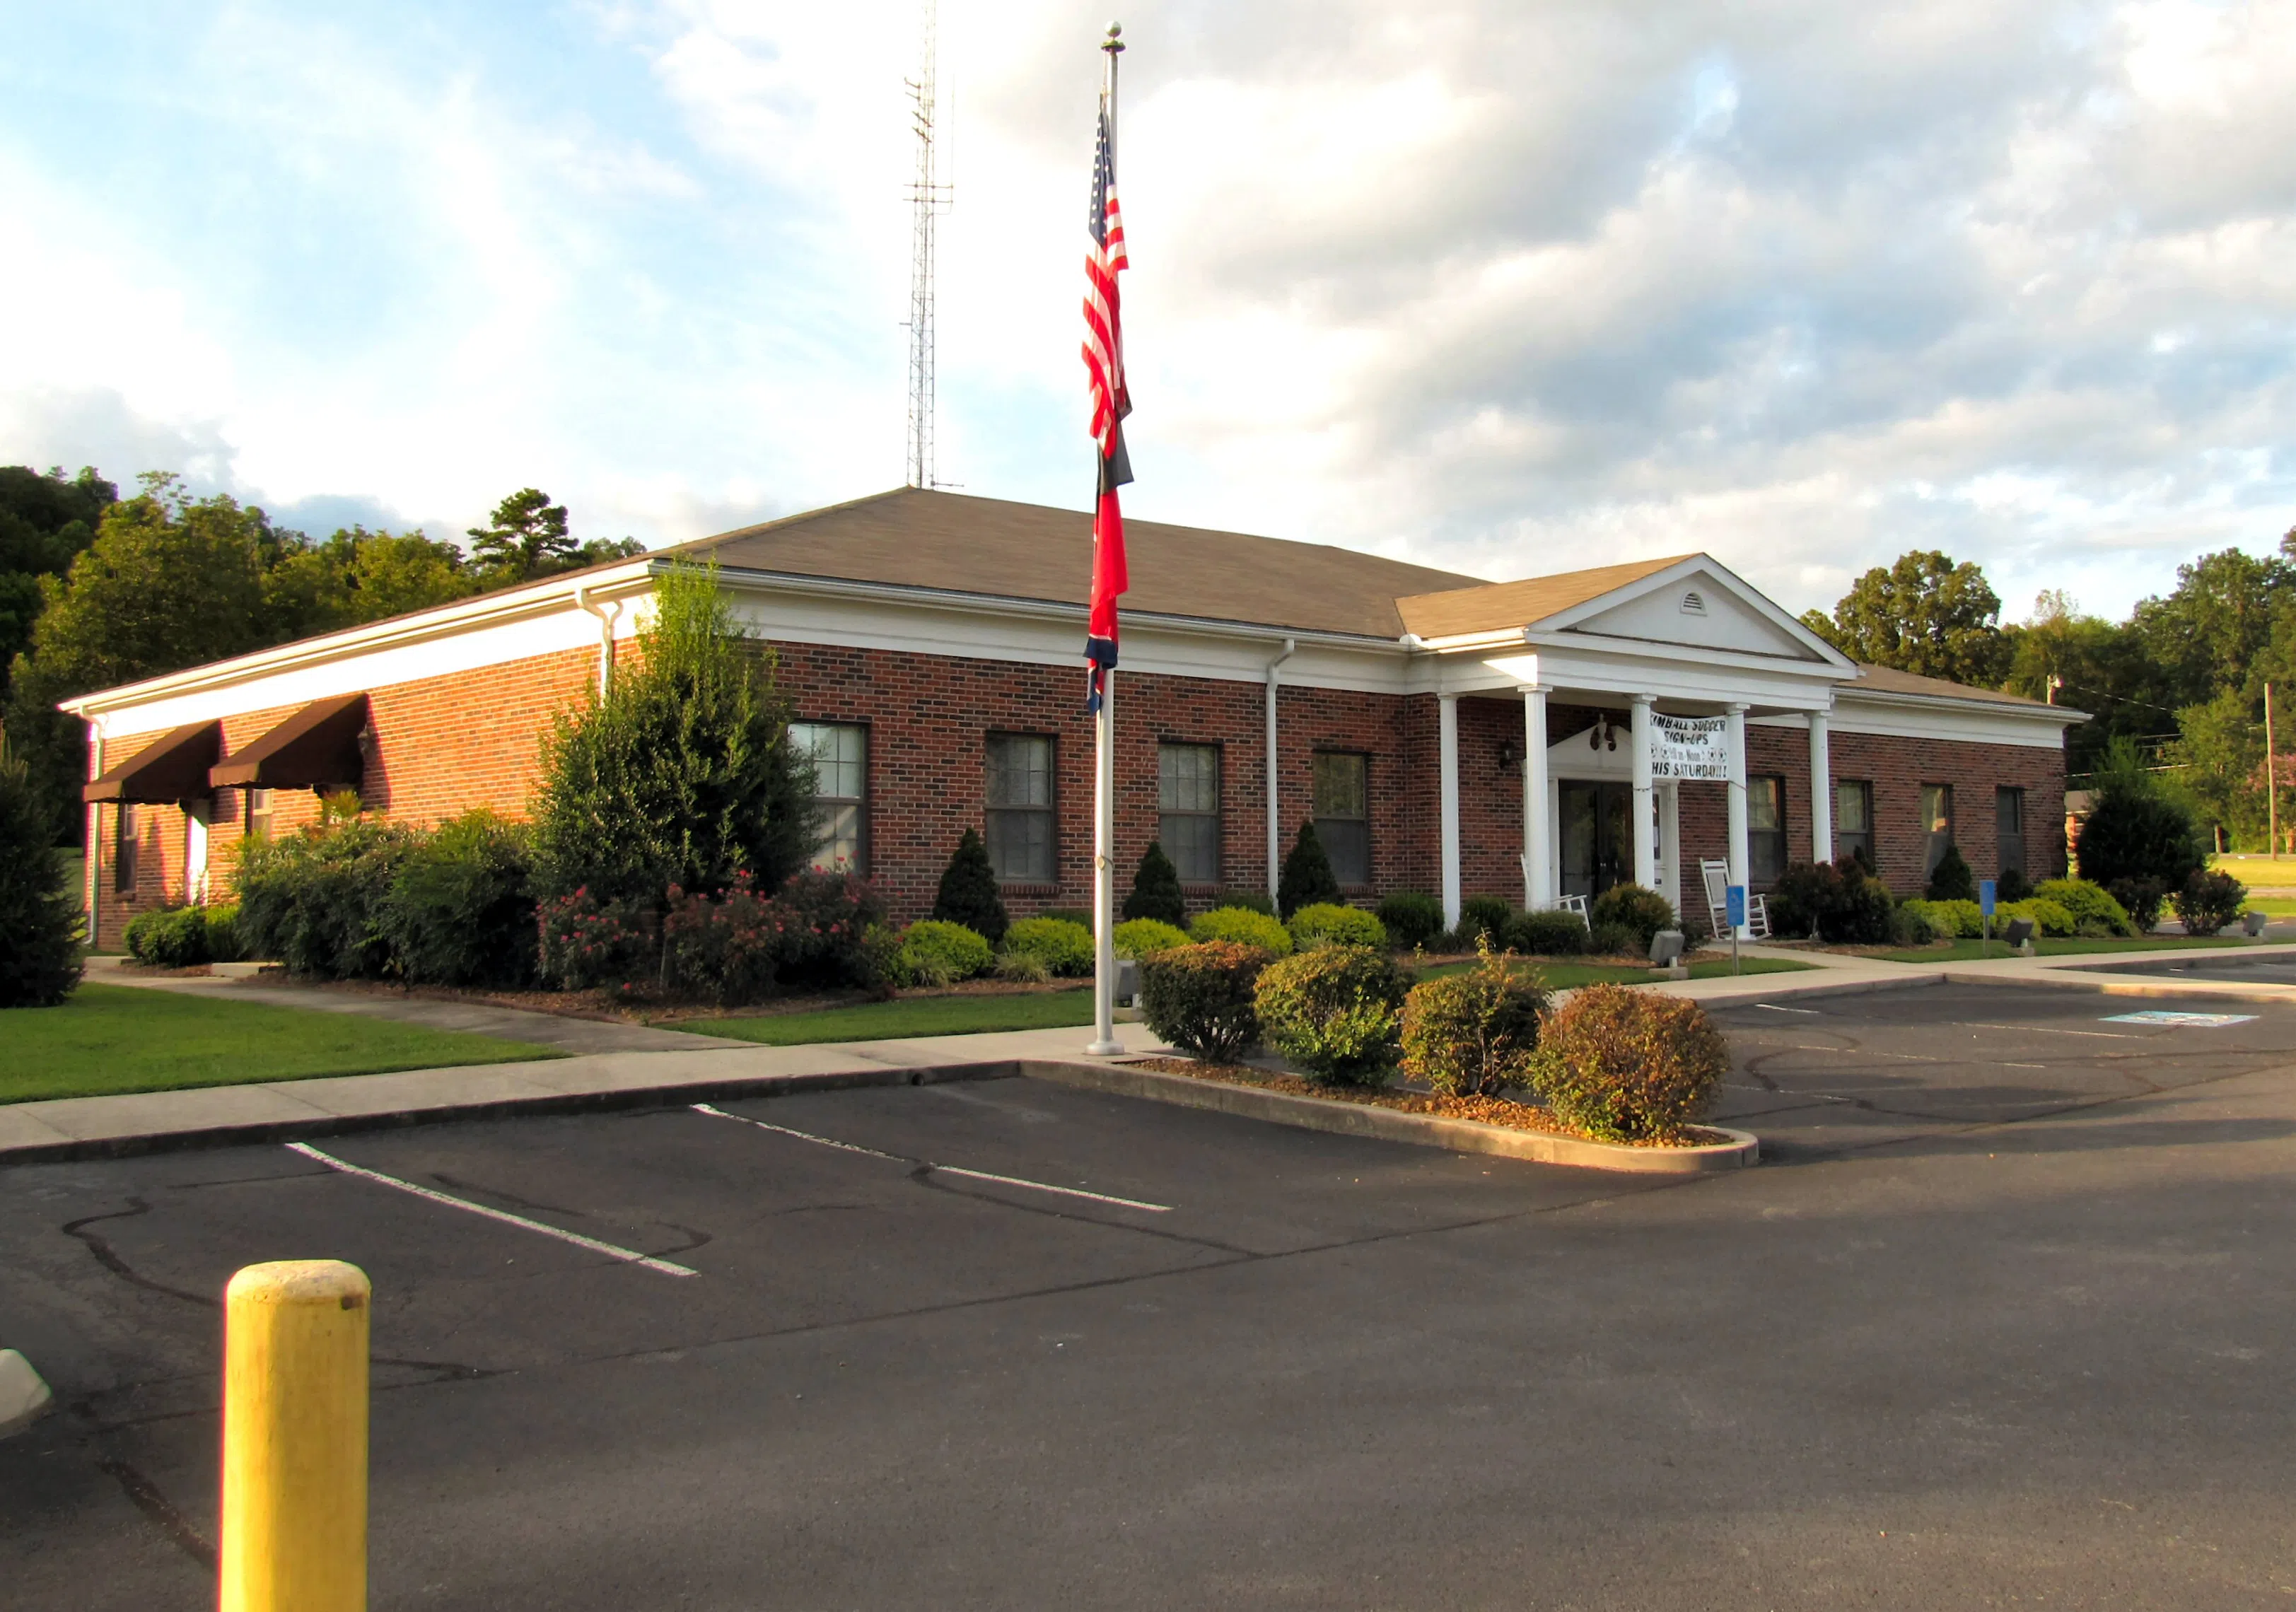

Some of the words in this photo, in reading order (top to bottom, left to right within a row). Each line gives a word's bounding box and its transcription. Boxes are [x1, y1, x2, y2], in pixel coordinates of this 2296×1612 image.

[1692, 720, 1725, 732] SOCCER
[1664, 731, 1708, 745] SIGN-UPS
[1652, 761, 1669, 776] HIS
